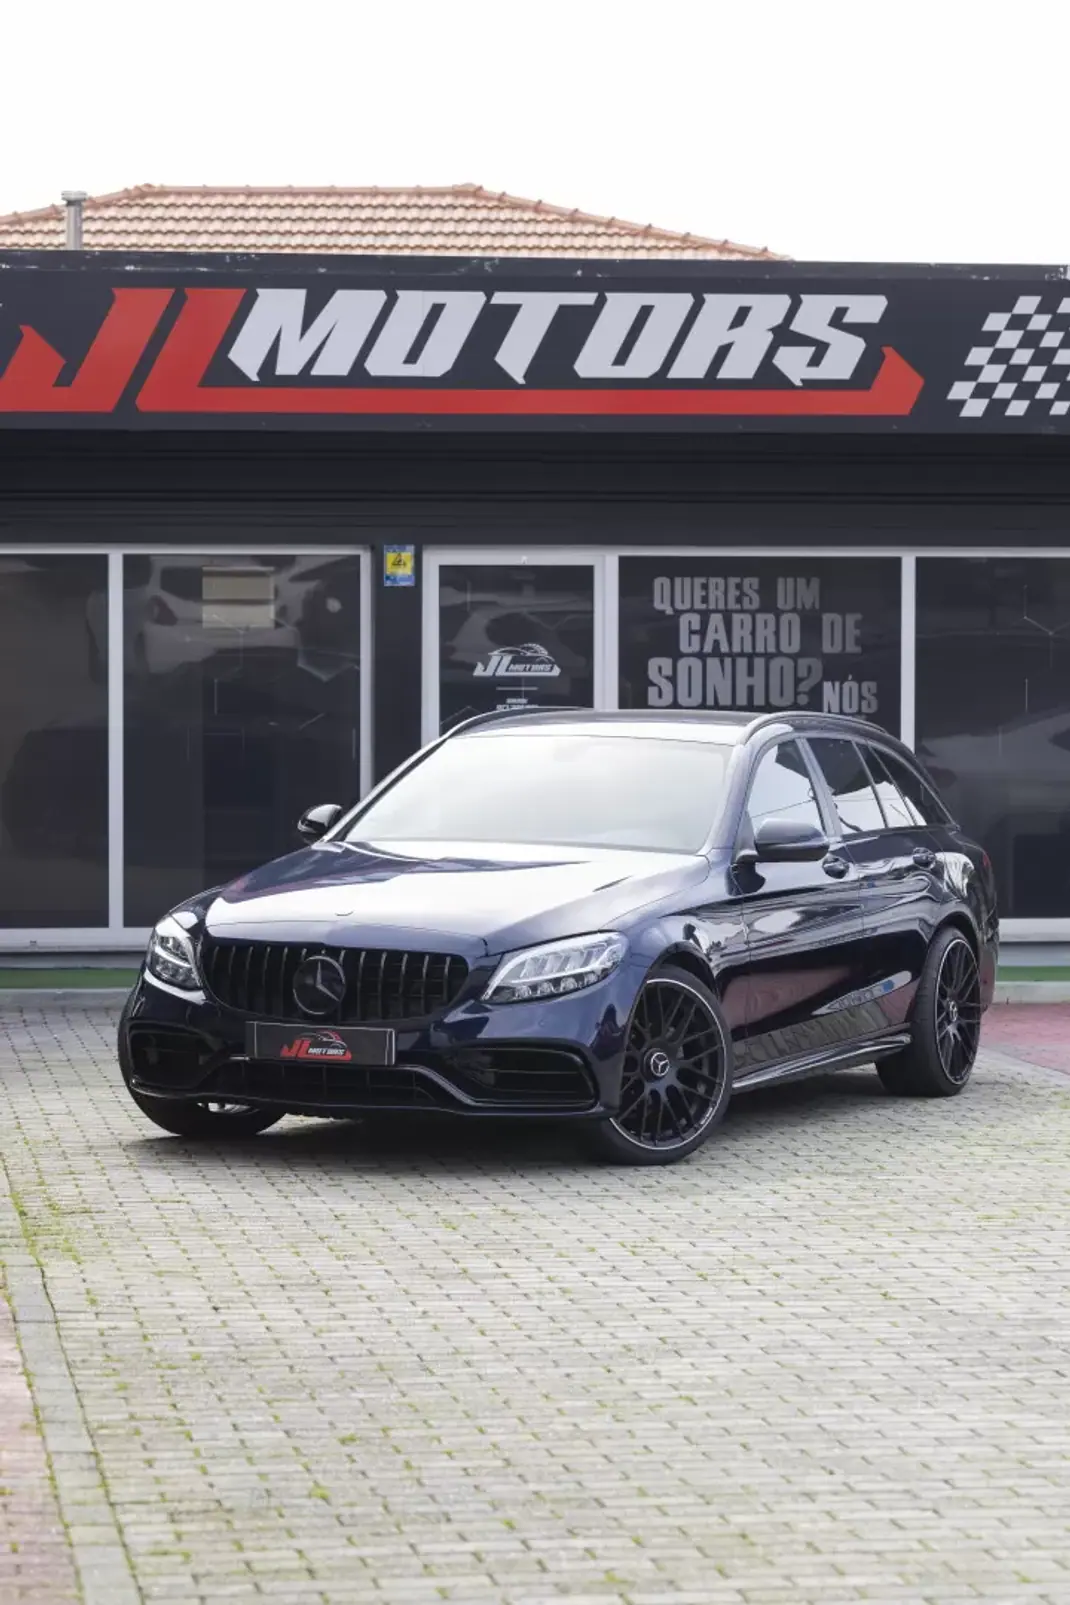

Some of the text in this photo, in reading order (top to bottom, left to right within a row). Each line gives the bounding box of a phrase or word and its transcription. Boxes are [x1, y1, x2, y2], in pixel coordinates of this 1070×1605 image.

[228, 288, 888, 386] MOTORS
[653, 577, 820, 614] QUERES UM
[679, 613, 862, 653] CARRO DE
[647, 657, 878, 713] SONHO? NÓS
